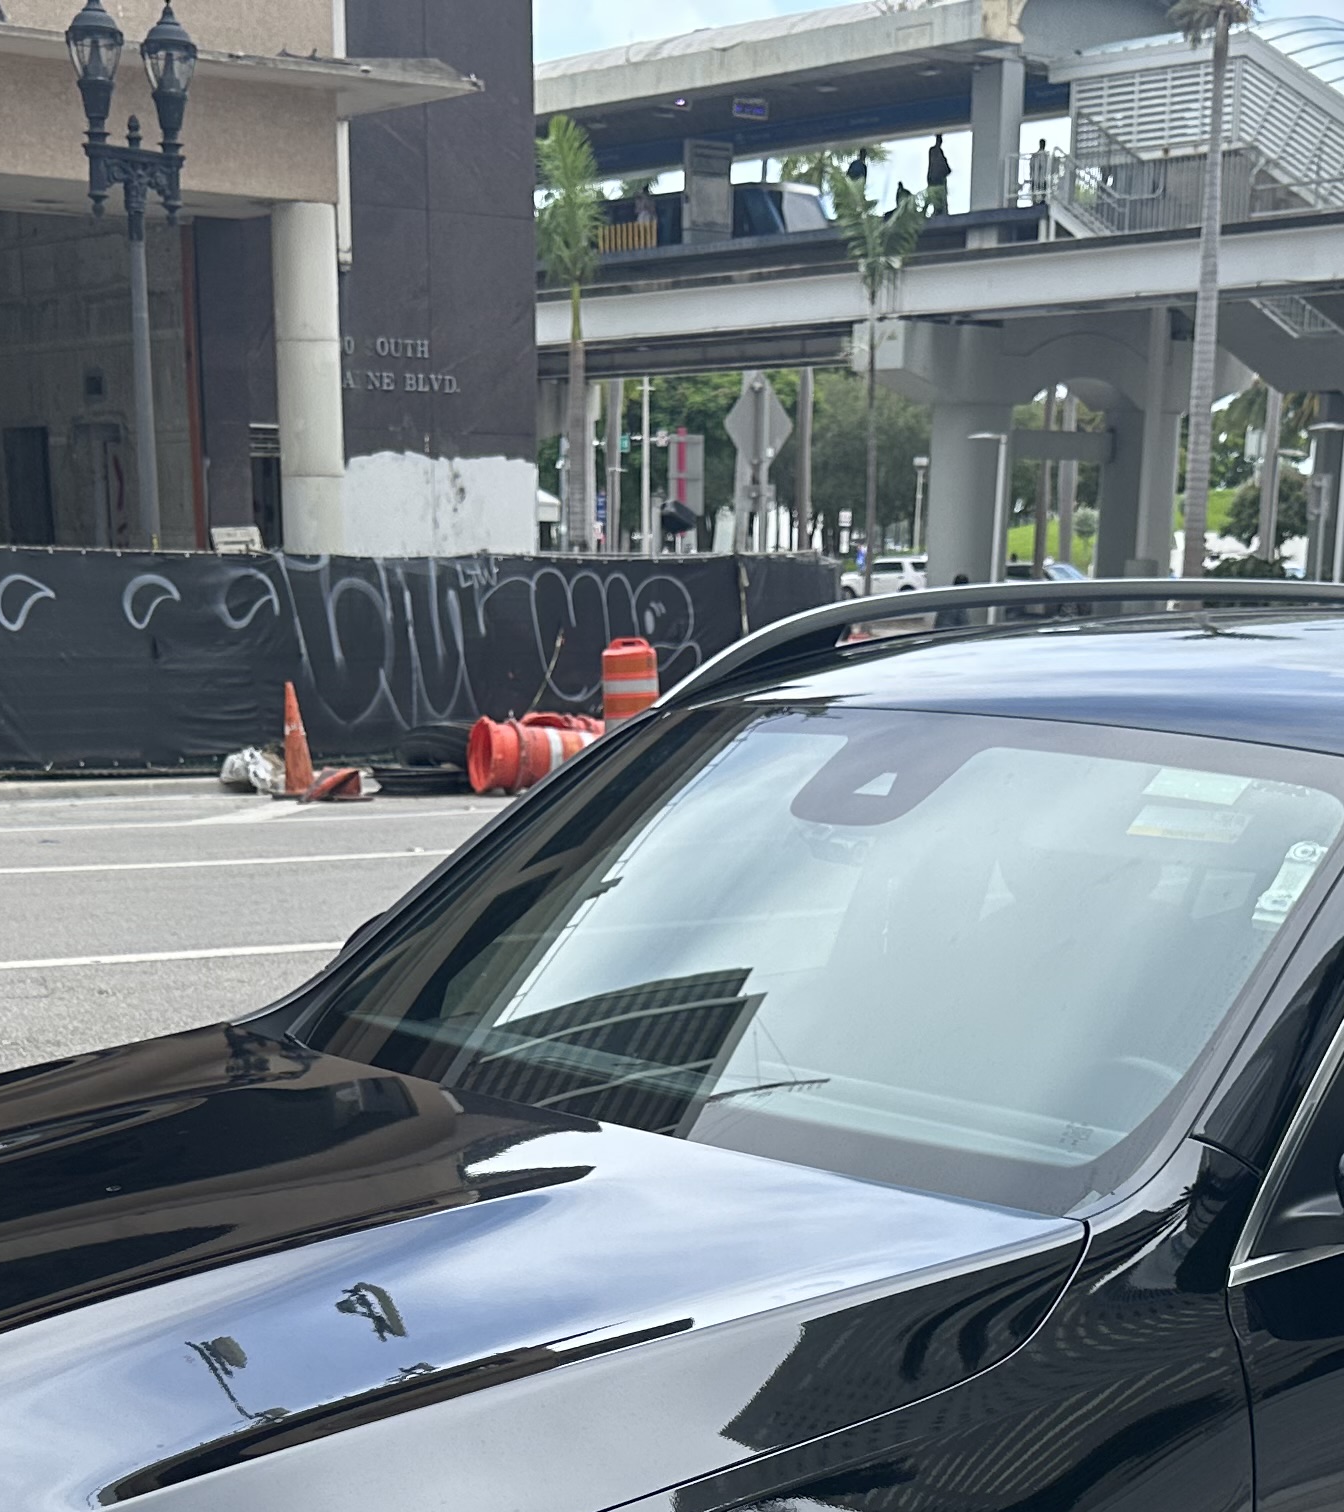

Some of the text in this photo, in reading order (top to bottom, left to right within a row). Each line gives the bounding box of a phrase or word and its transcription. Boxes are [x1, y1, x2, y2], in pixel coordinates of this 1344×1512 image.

[367, 337, 429, 358] OUTH
[342, 369, 461, 394] ANE BLVD.
